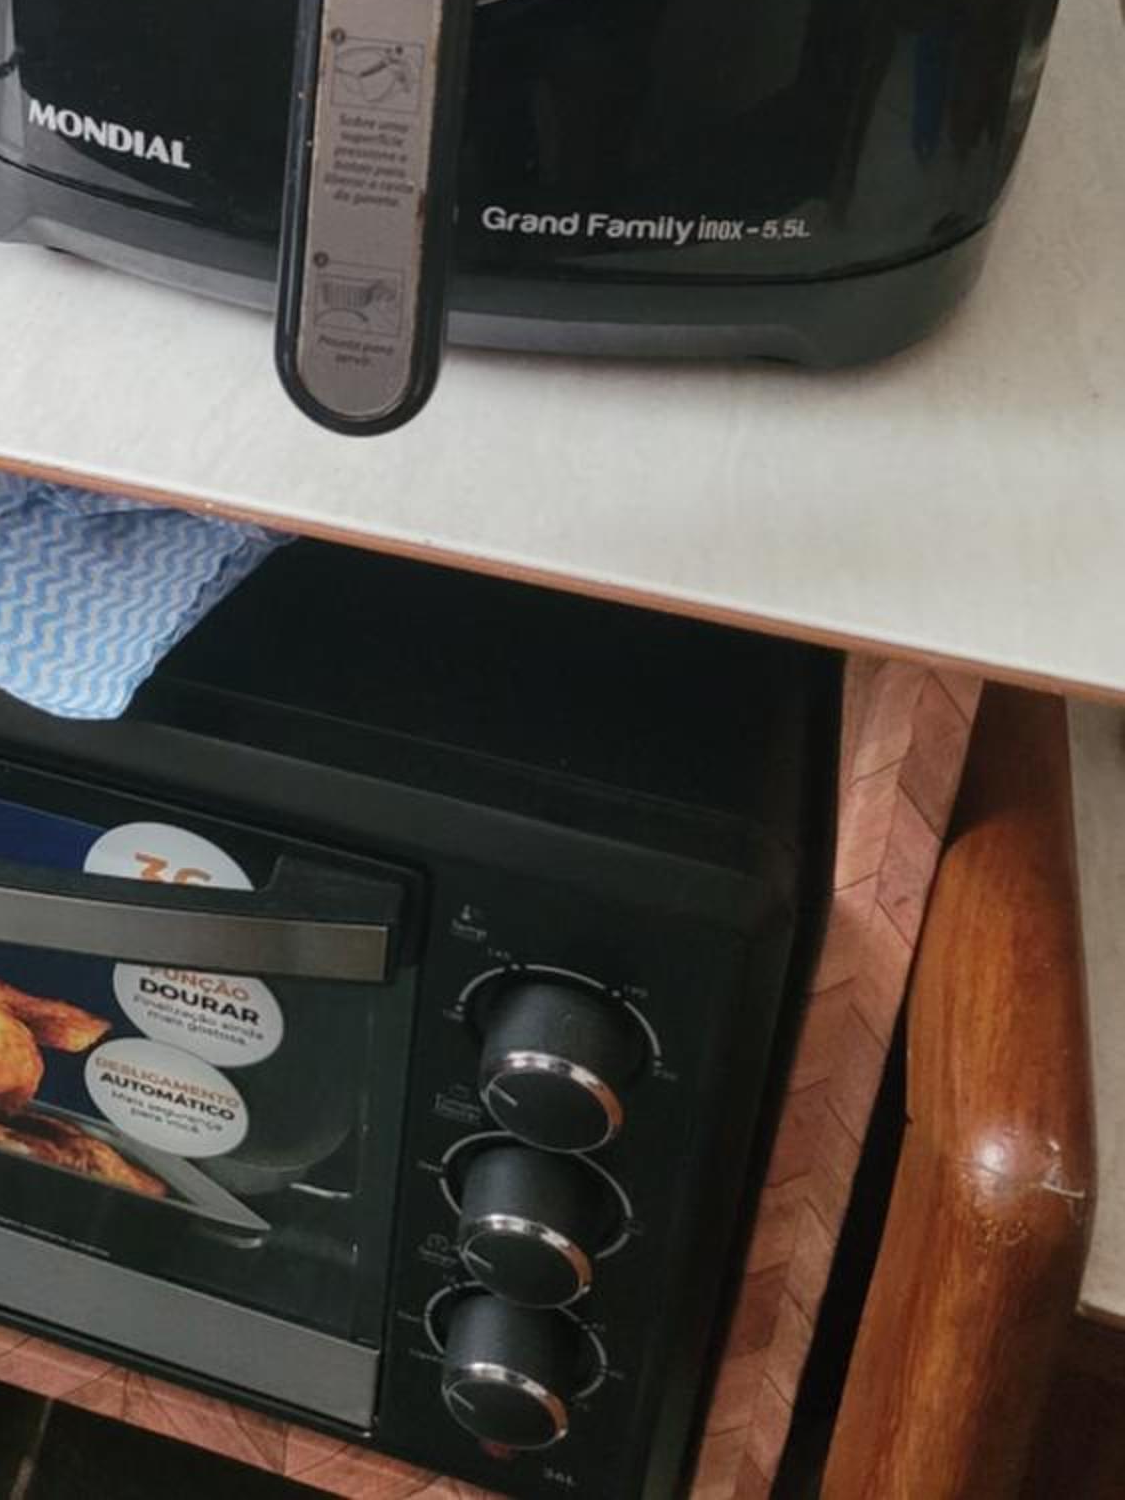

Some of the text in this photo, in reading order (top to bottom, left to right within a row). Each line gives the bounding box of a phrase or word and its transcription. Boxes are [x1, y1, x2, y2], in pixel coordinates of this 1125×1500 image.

[27, 98, 192, 170] MONDIAL
[481, 205, 579, 237] Grand
[586, 212, 695, 245] Family
[138, 976, 261, 1026] DOURAR
[99, 1071, 236, 1122] AUTOMÁTICO
